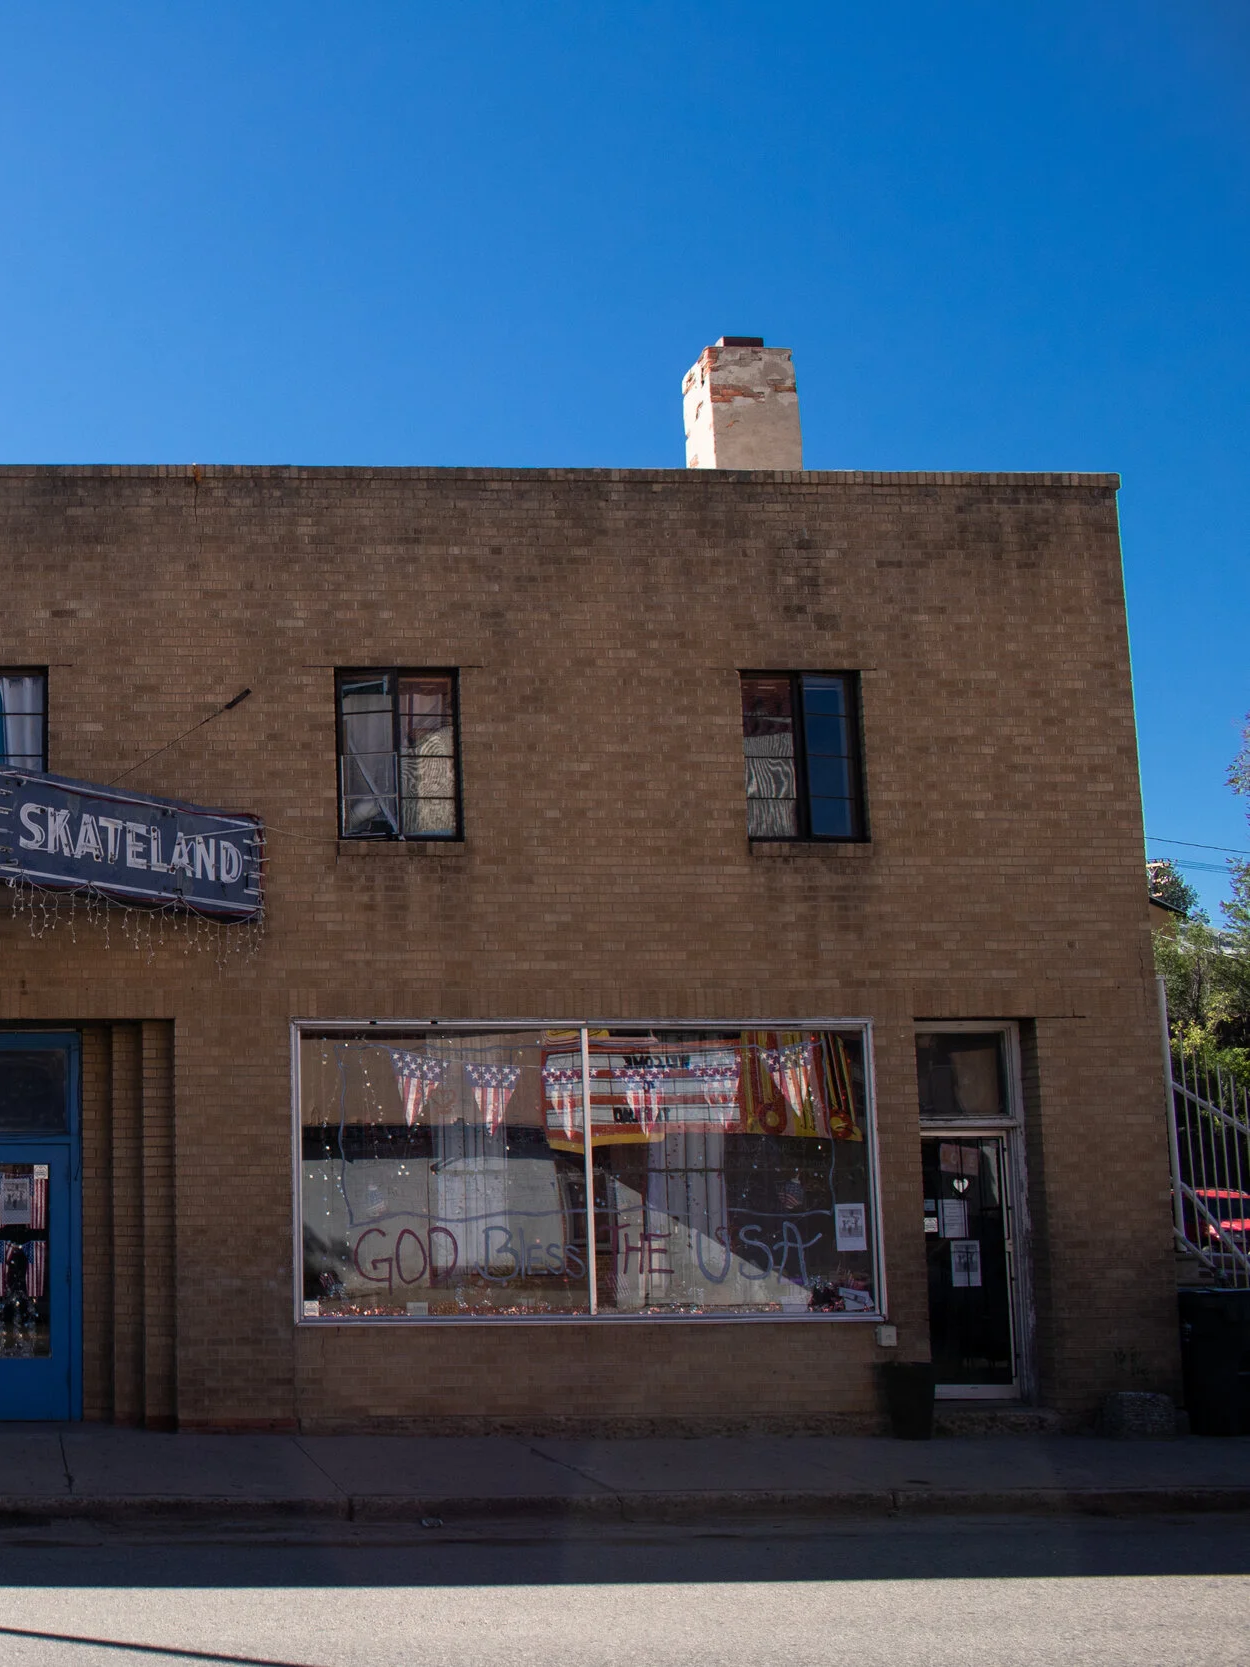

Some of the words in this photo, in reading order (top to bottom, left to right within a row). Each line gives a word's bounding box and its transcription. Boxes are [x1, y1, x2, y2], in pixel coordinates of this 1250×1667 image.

[19, 803, 243, 885] SKATELAND
[353, 1226, 458, 1295] GOD
[597, 1223, 674, 1276] THE
[695, 1221, 822, 1286] USA
